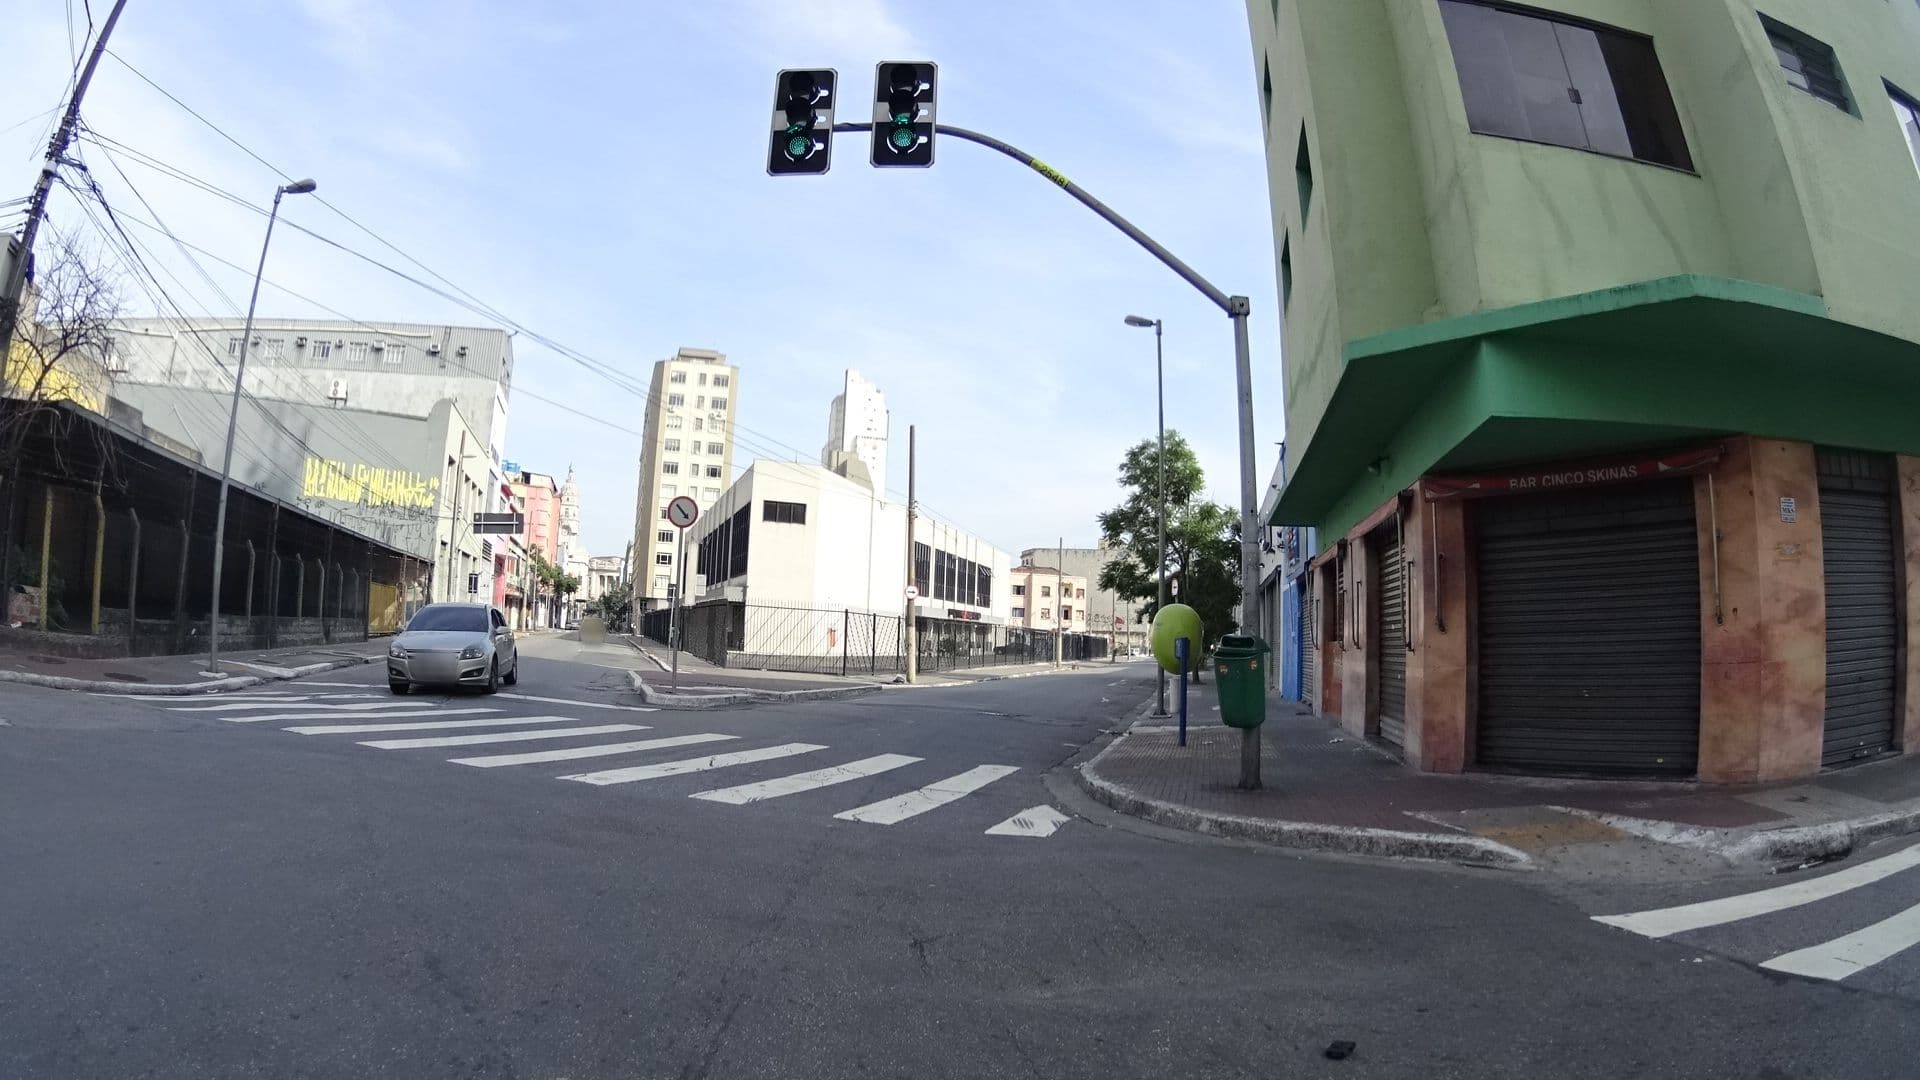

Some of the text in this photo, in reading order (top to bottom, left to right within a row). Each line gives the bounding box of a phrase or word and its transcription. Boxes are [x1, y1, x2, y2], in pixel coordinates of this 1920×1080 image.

[1509, 465, 1638, 489] BAR CINCO SKINAS
